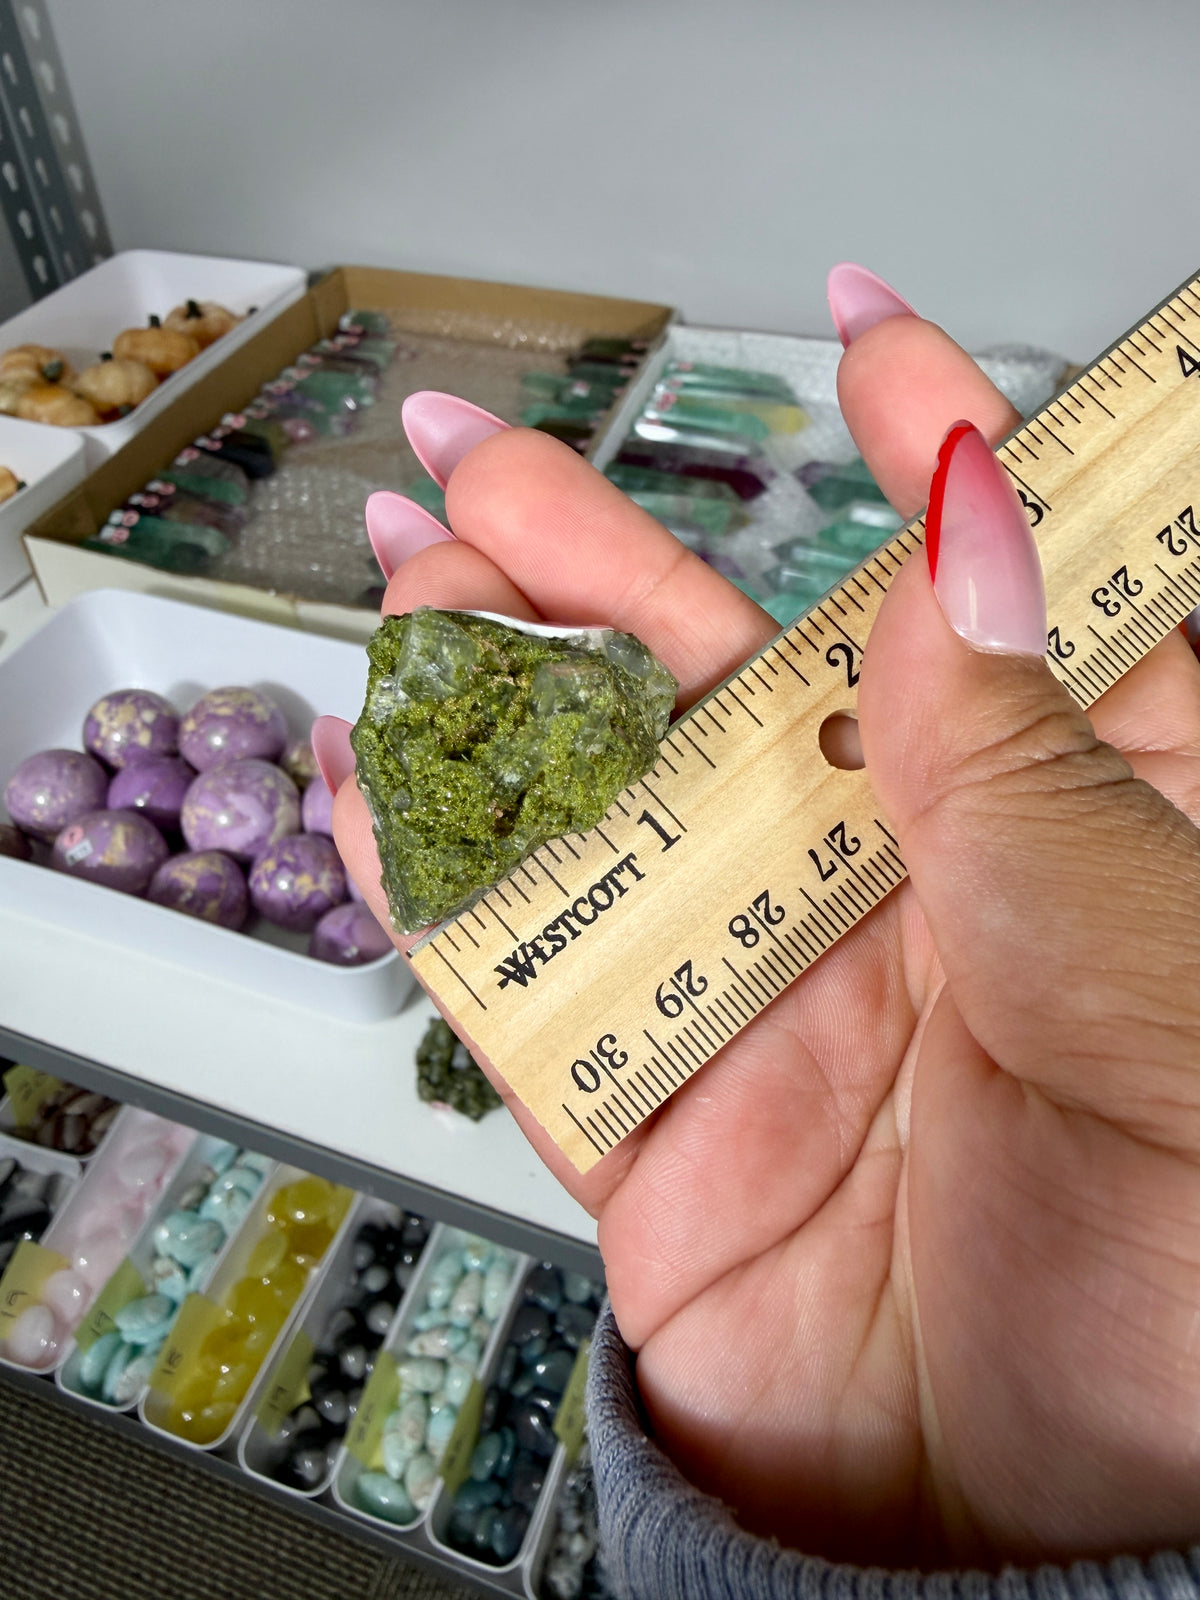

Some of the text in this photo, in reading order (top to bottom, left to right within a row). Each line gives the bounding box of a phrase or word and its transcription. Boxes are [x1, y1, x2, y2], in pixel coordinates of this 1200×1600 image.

[1091, 565, 1144, 617] 23
[826, 642, 862, 688] 2
[637, 809, 682, 853] 1
[808, 820, 861, 882] 27
[496, 852, 646, 990] WESTCOTT
[728, 889, 786, 948] 28
[655, 959, 709, 1019] 29
[570, 1033, 629, 1094] 30
